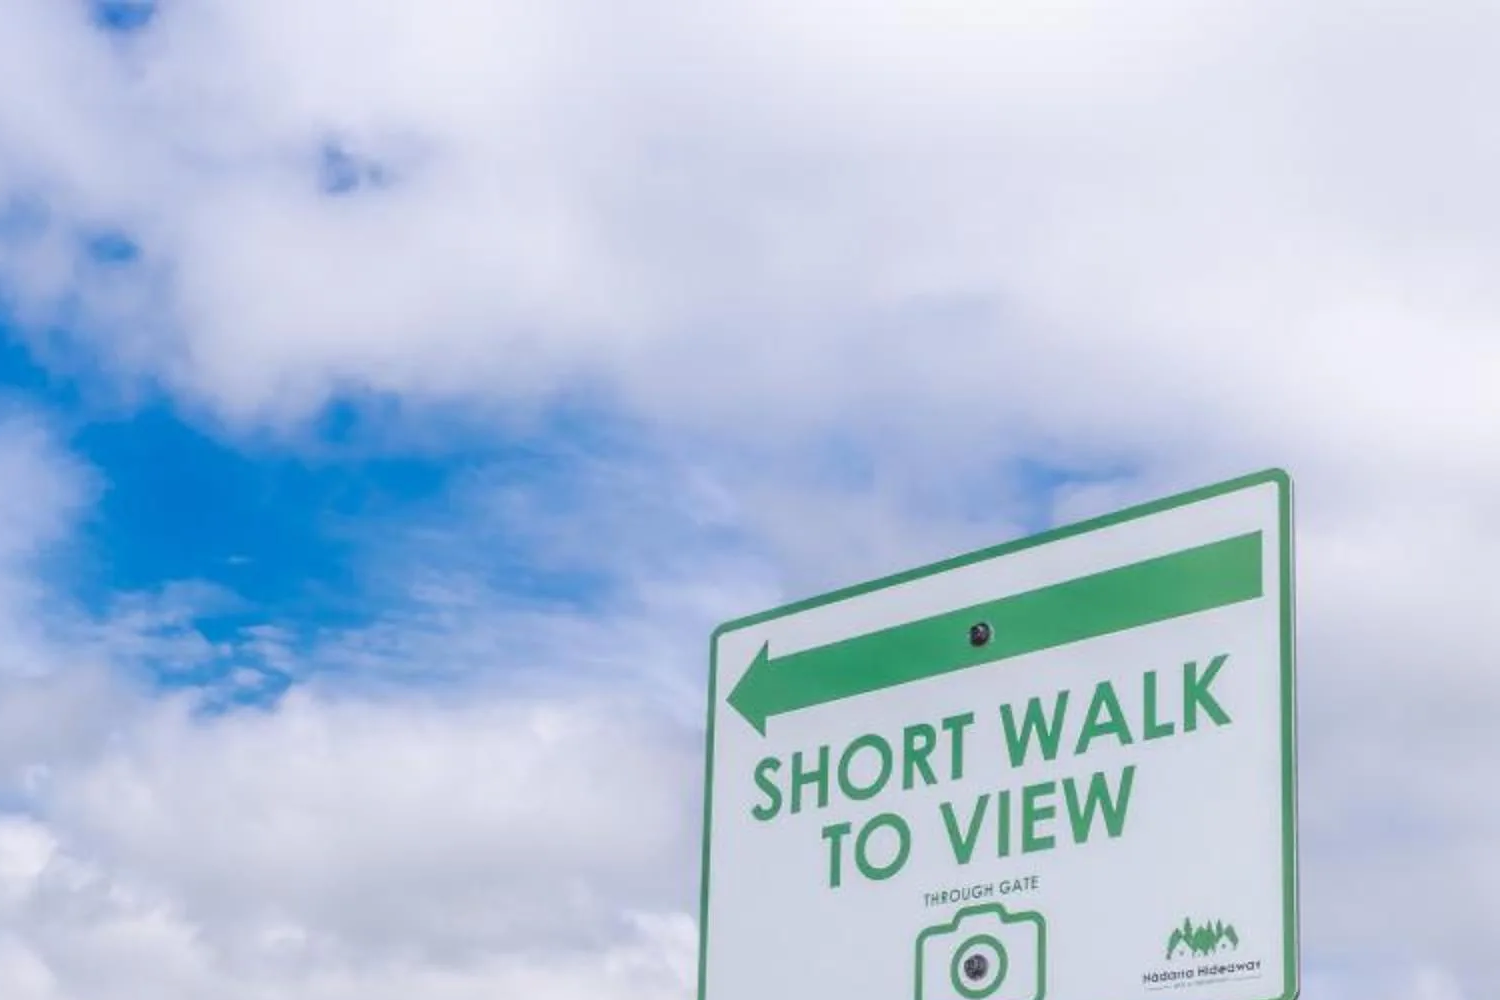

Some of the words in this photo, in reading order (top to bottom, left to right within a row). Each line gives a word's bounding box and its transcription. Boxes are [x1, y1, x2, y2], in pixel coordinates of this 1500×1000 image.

[751, 711, 975, 822] SHORT
[1000, 653, 1233, 769] WALK
[821, 812, 912, 888] TO
[939, 765, 1137, 866] VIEW
[923, 883, 994, 907] THROUGH
[999, 875, 1040, 895] GATE
